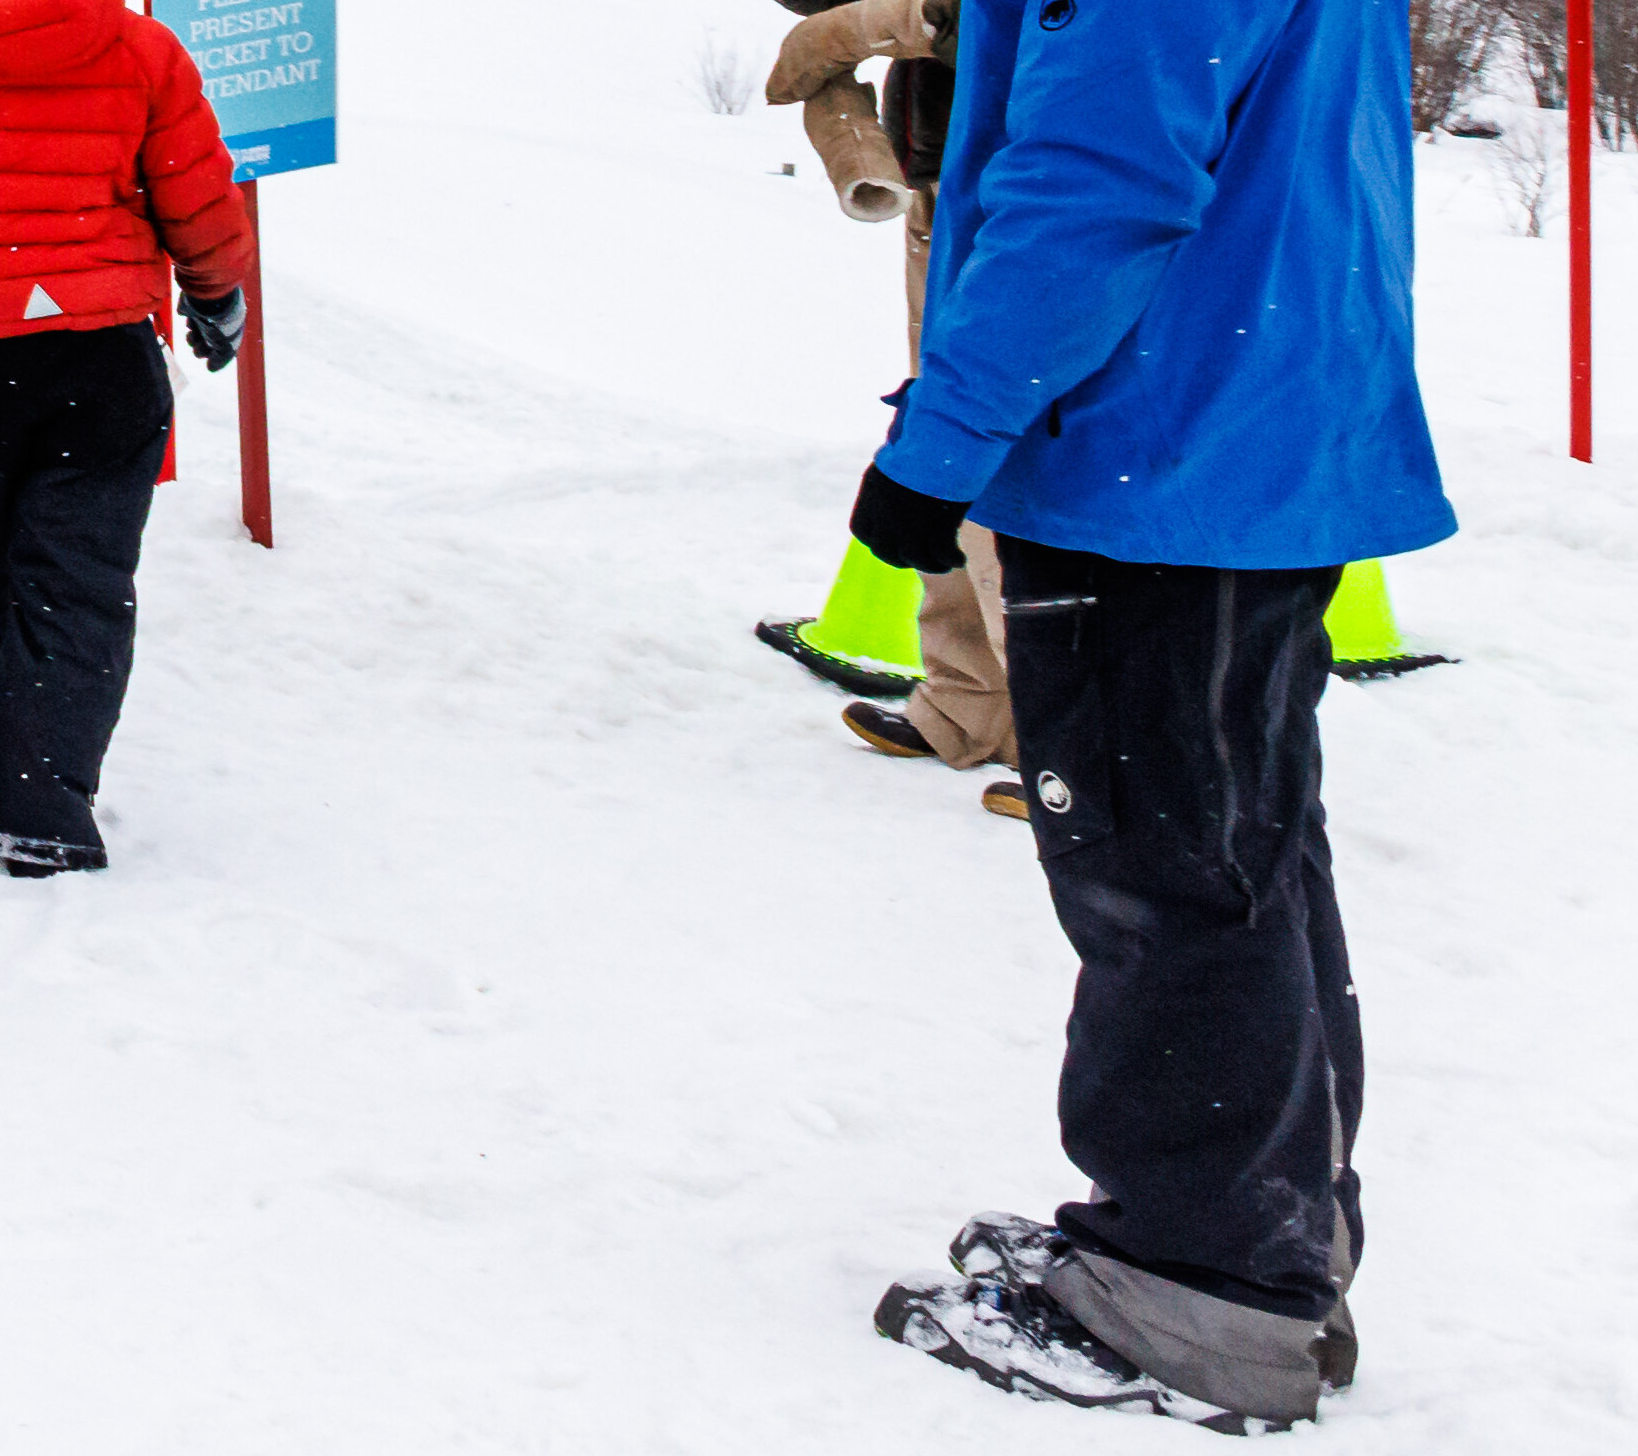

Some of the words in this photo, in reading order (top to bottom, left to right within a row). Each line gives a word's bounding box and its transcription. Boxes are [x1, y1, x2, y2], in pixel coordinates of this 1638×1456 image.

[190, 3, 302, 42] PRESENT
[276, 31, 314, 56] TO
[203, 59, 321, 99] TENDANT
